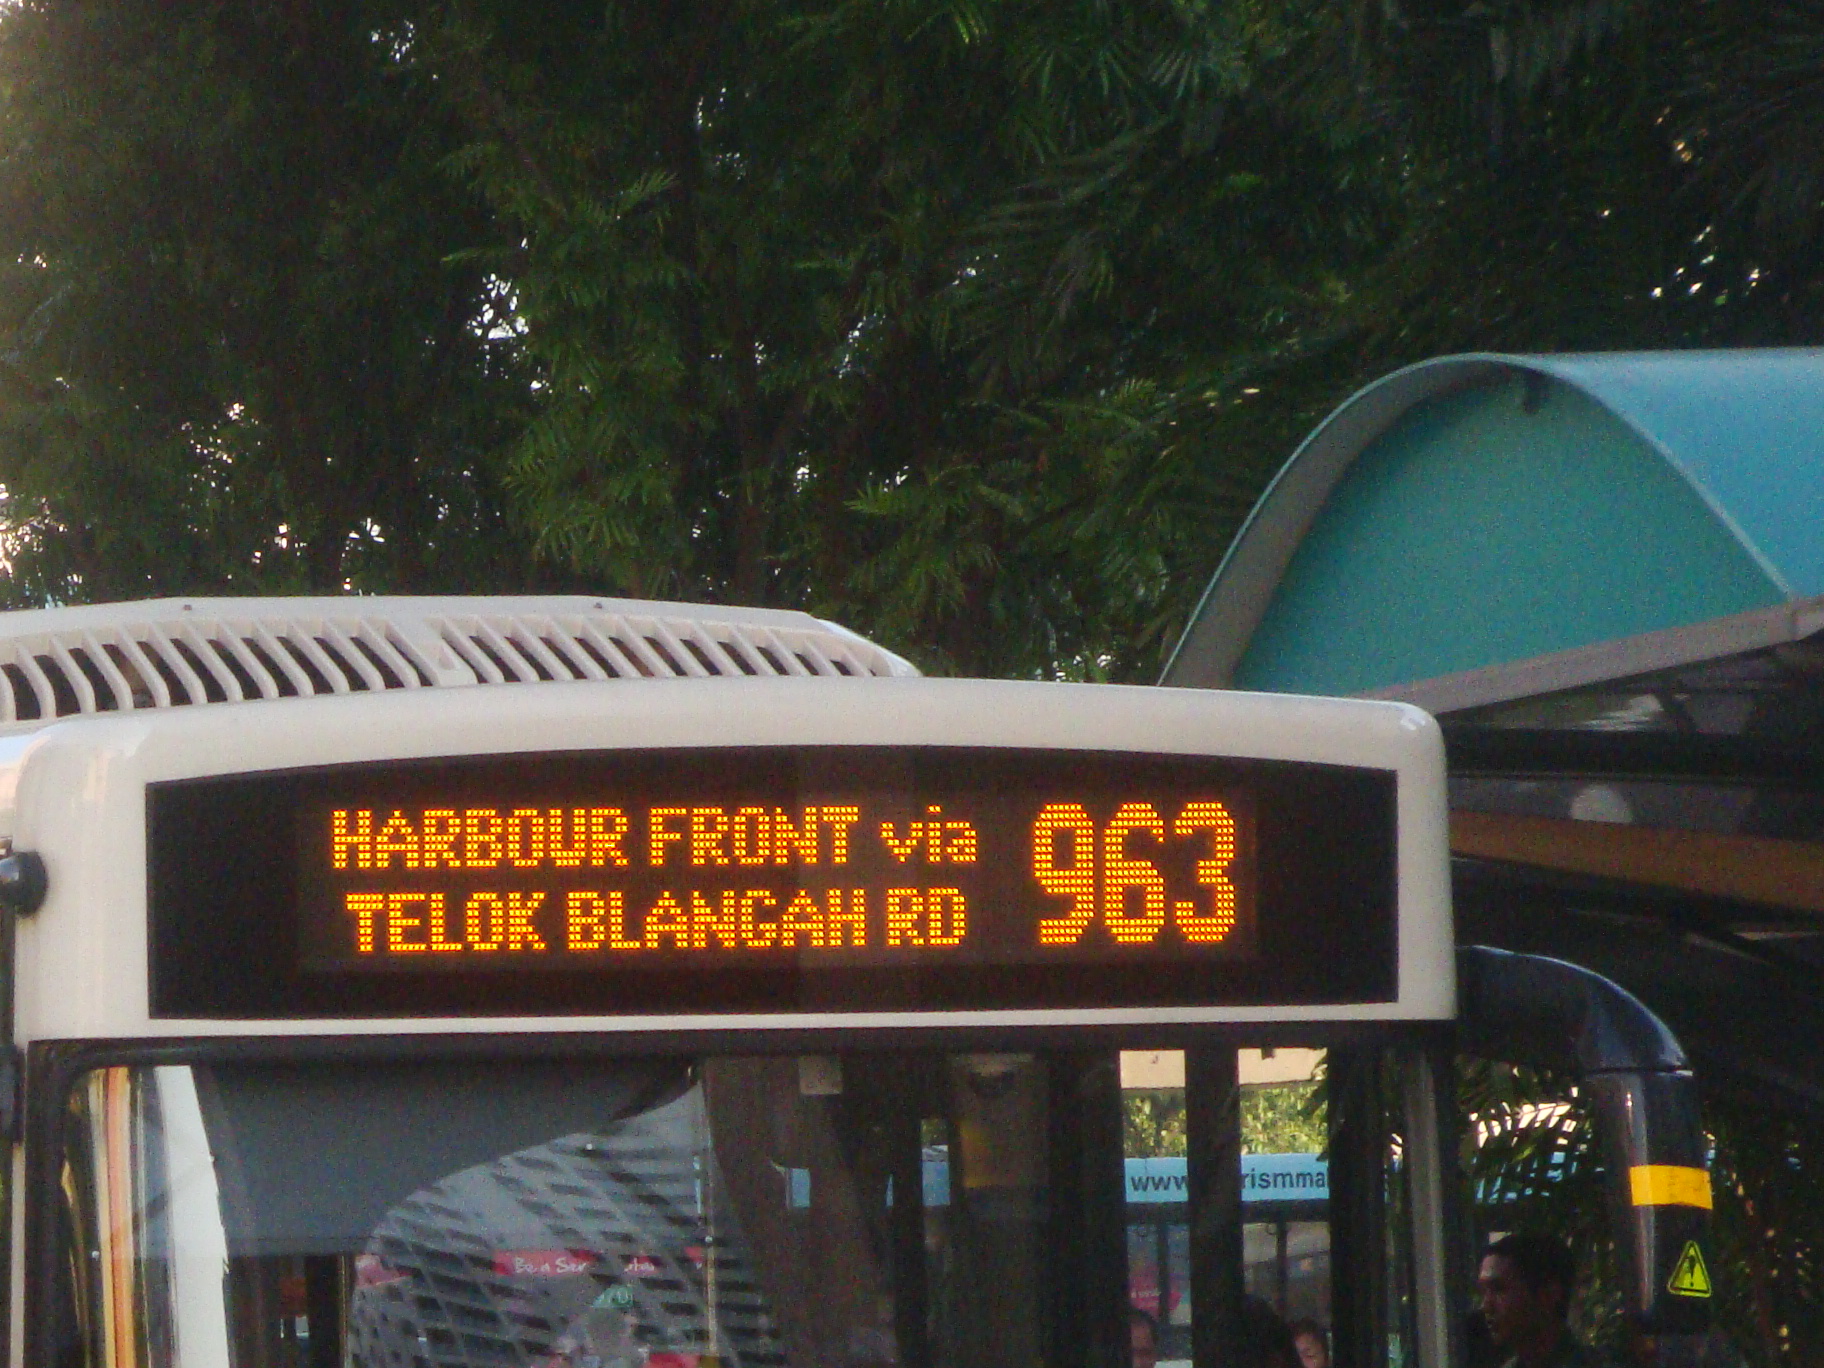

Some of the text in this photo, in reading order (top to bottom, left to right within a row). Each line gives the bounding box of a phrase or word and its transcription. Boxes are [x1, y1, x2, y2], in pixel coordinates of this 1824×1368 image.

[332, 803, 978, 868] HARBOUR FRONT via
[1033, 802, 1237, 944] 963
[345, 887, 968, 952] TELOK BLANGAH RD
